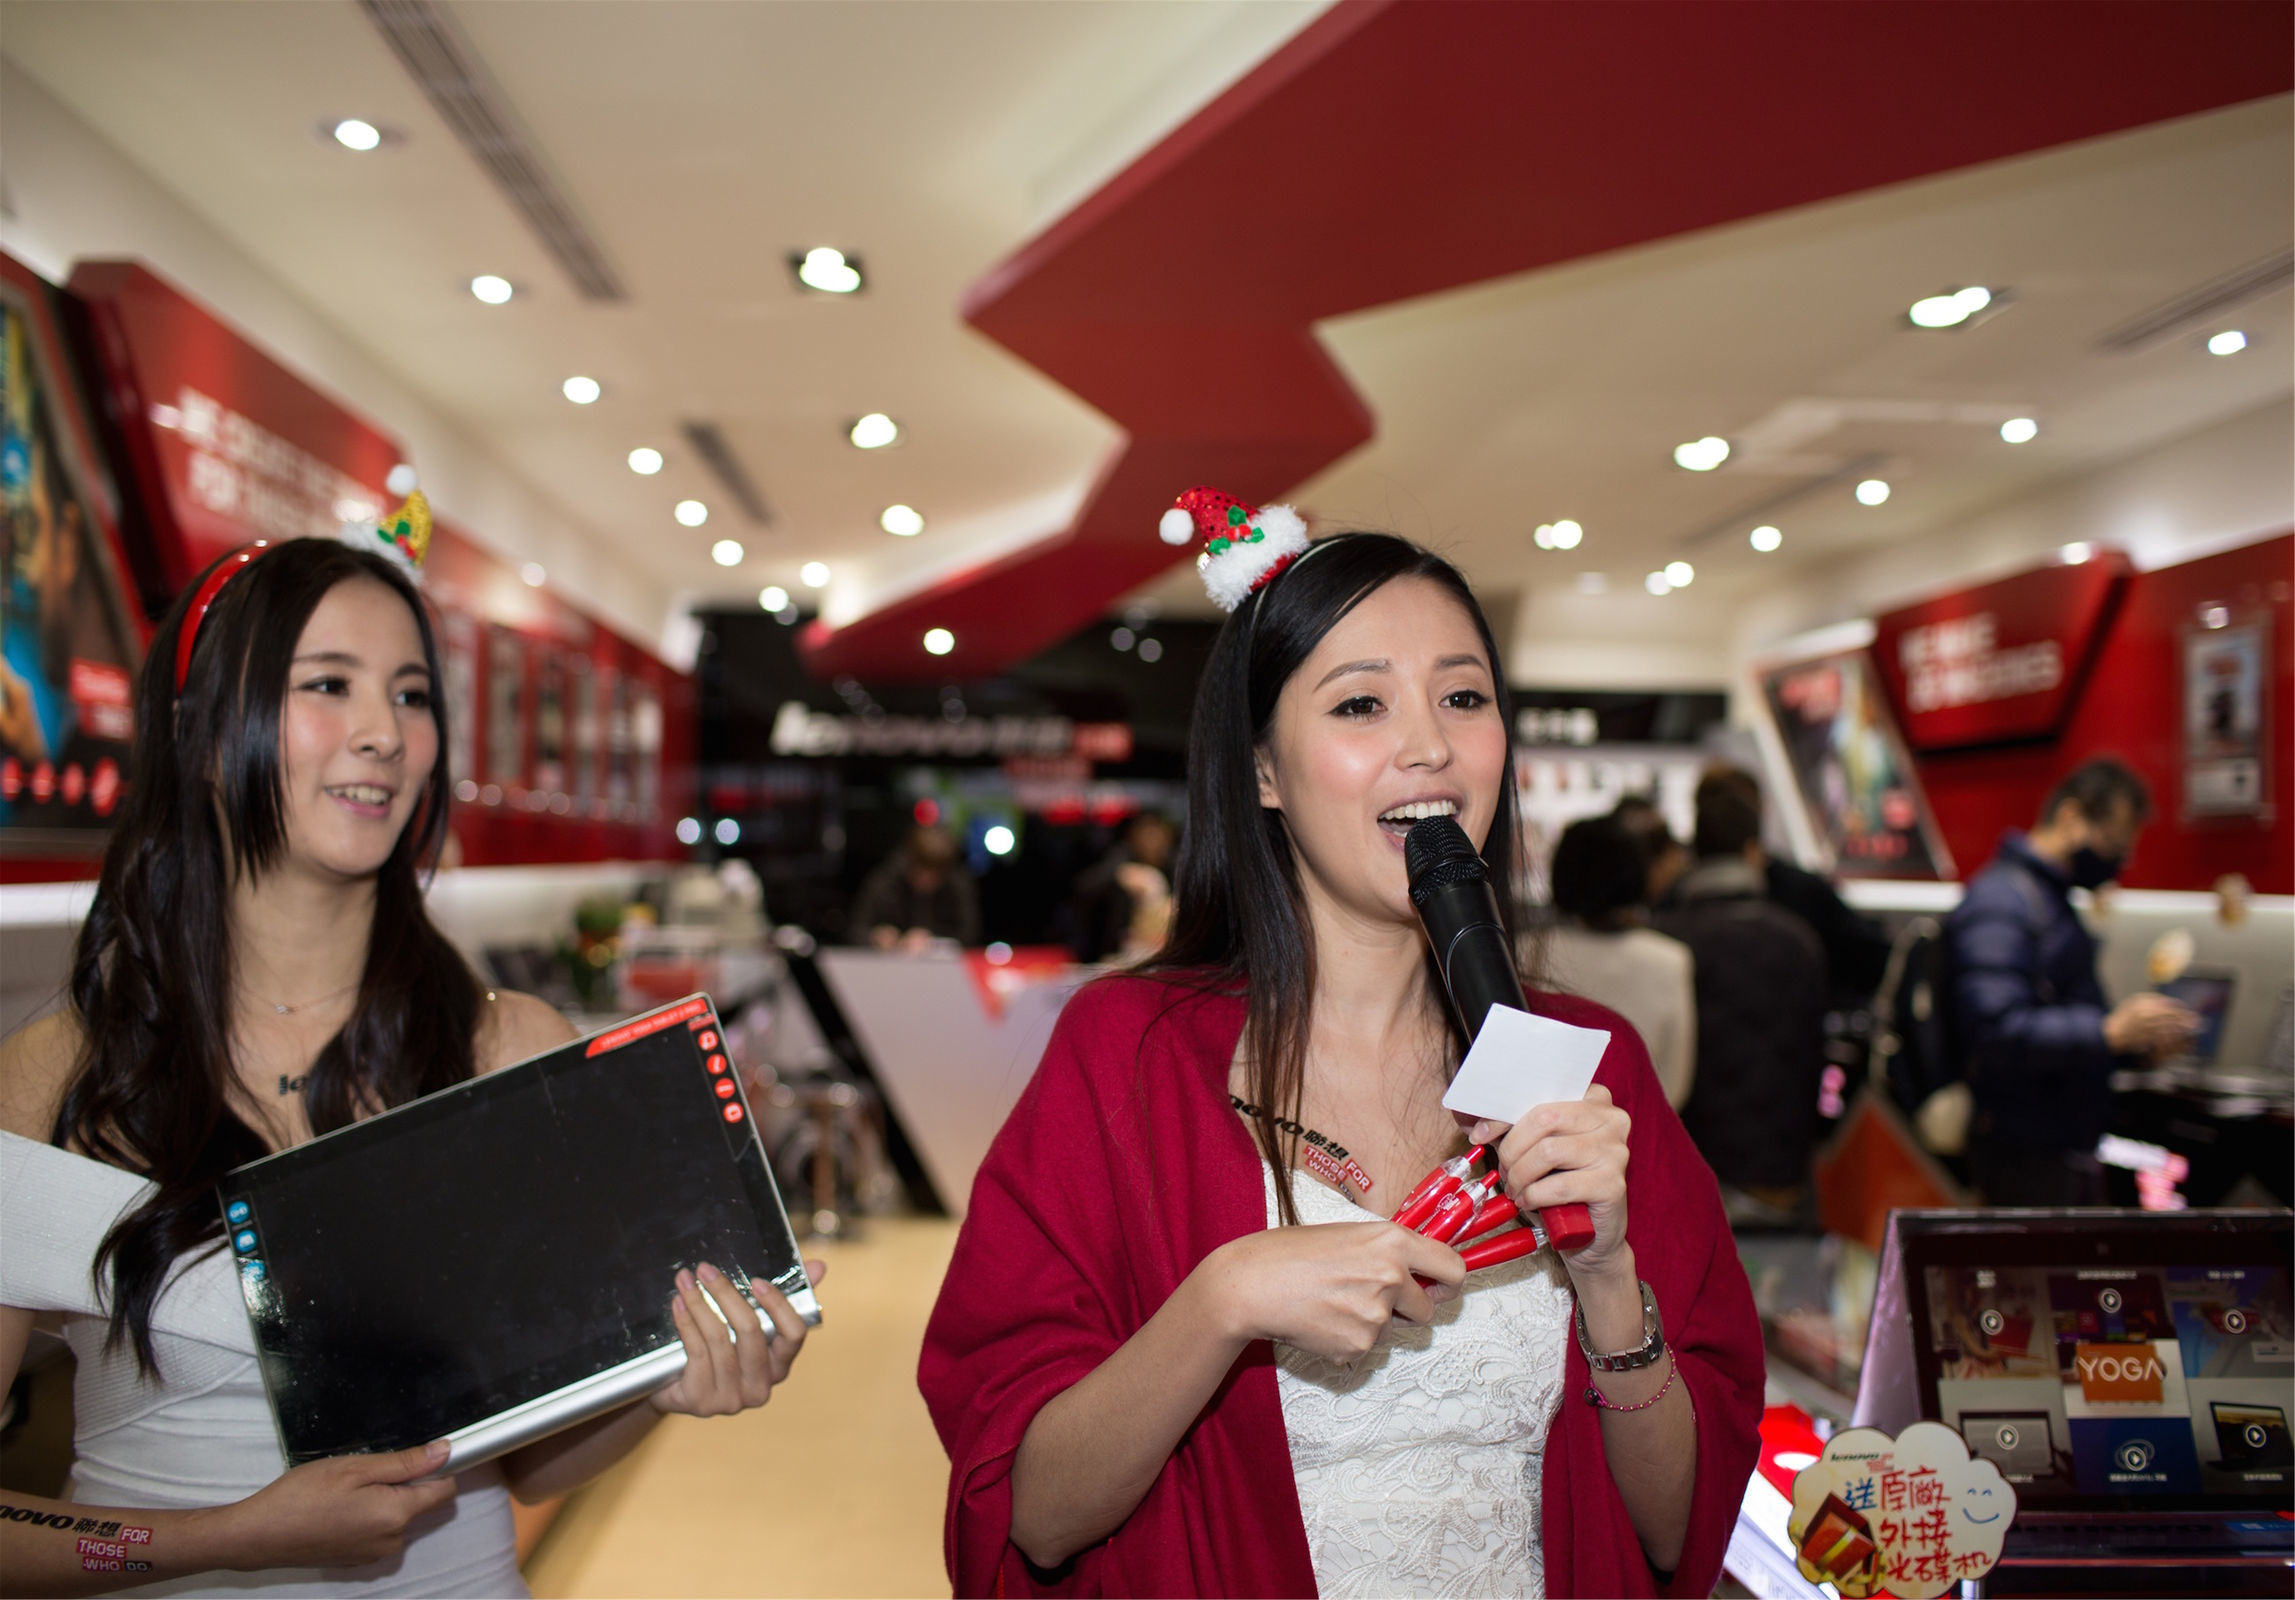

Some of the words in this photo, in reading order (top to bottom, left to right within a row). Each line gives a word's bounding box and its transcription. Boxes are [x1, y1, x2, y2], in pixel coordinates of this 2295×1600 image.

[1307, 1147, 1346, 1179] THOSE
[1309, 1160, 1337, 1182] WHO
[1346, 1161, 1370, 1190] FOR
[2078, 1356, 2166, 1381] YOGA
[121, 1528, 150, 1543] FOR
[1879, 1509, 1952, 1550] 外接
[79, 1540, 125, 1557] THOSE
[85, 1559, 120, 1571] WHO
[126, 1562, 148, 1571] DO
